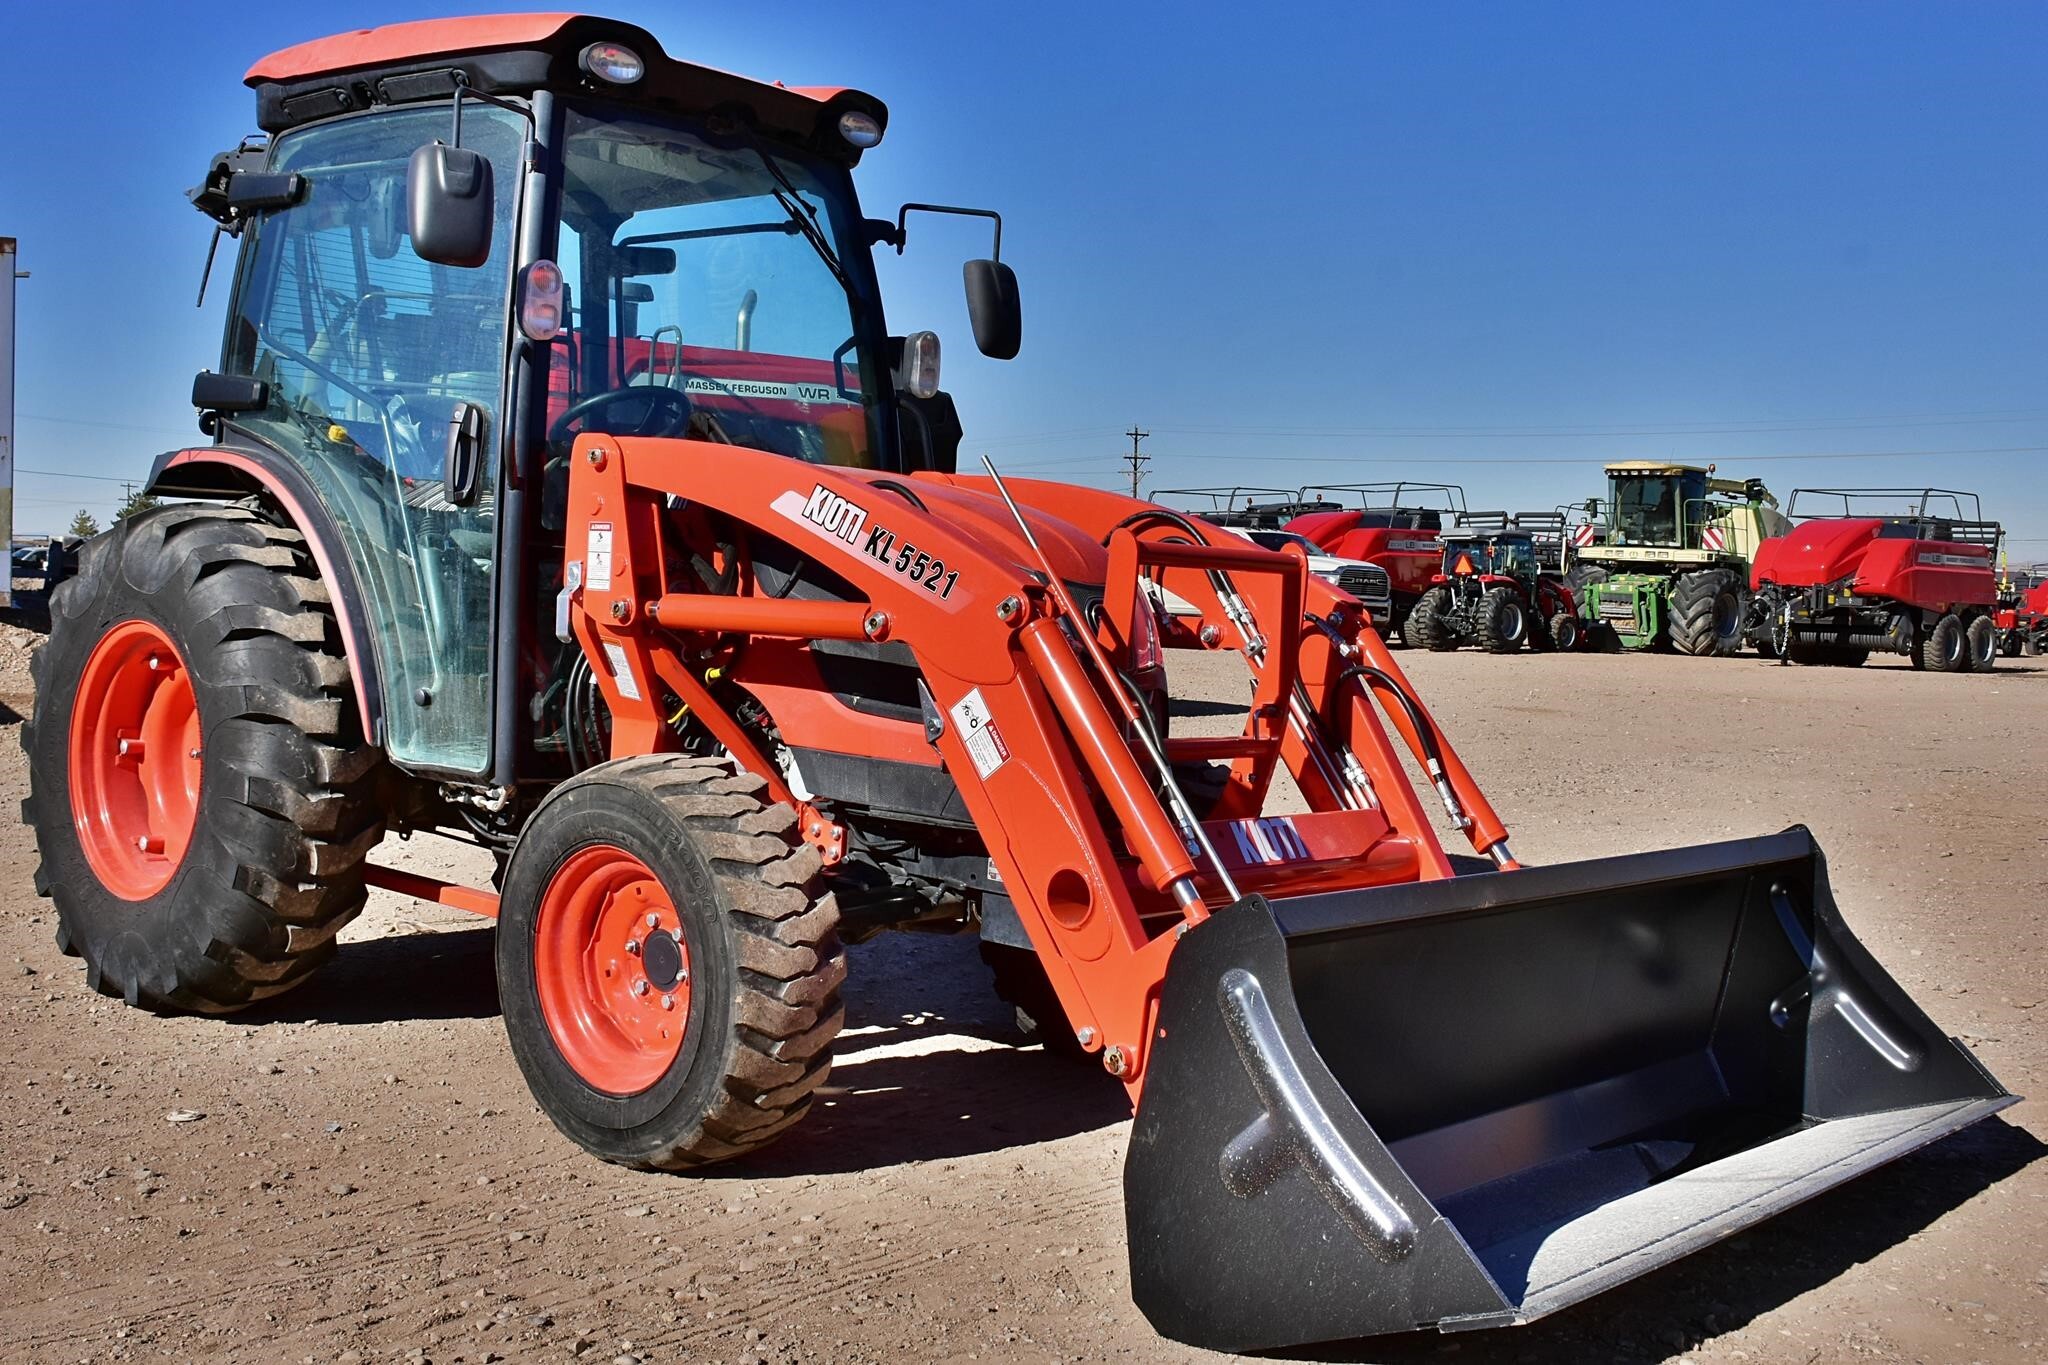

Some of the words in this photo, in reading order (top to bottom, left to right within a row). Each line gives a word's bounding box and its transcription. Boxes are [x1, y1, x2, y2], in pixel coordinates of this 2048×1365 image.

[685, 380, 728, 391] MASSEY
[731, 384, 788, 396] FERGUSON
[797, 386, 831, 400] WR
[802, 483, 869, 545] KIOTI
[991, 731, 1009, 758] DANGER
[1229, 816, 1309, 865] KIOTI
